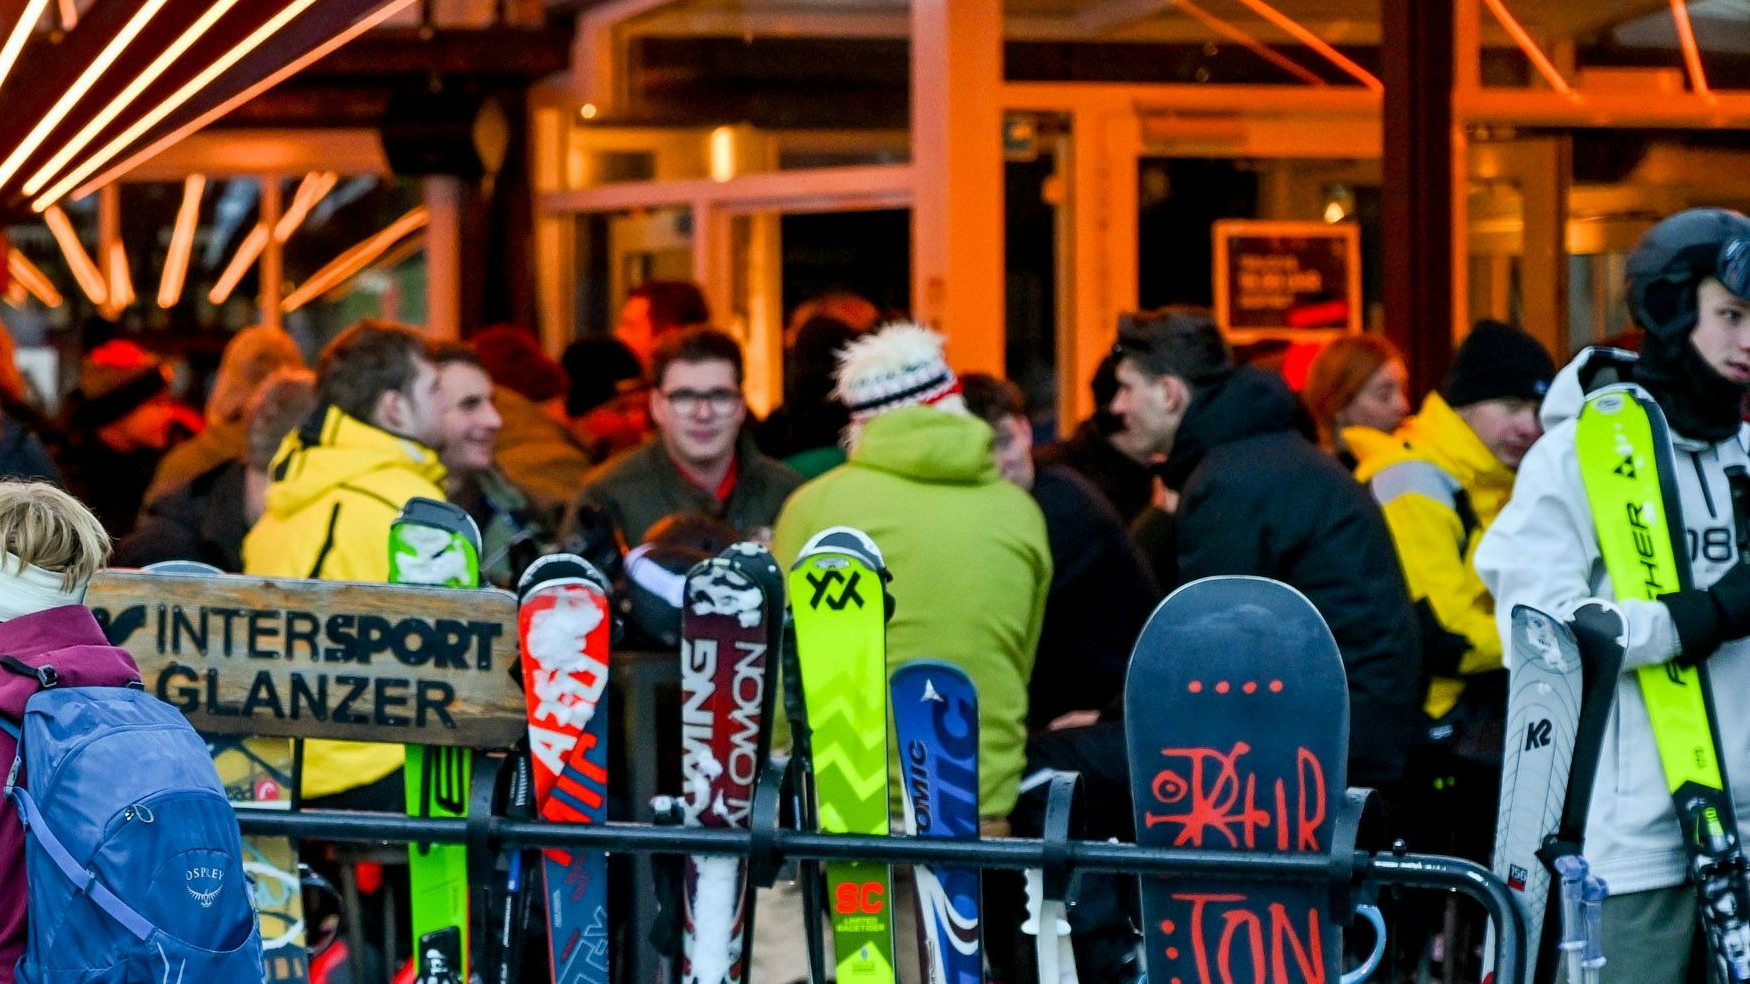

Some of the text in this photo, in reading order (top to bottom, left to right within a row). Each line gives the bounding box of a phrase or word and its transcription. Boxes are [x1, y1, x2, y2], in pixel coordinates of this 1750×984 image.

[156, 604, 503, 671] INTERSPORT
[156, 663, 456, 729] GLANZER
[727, 640, 767, 827] ALOMON
[1525, 718, 1552, 751] K2
